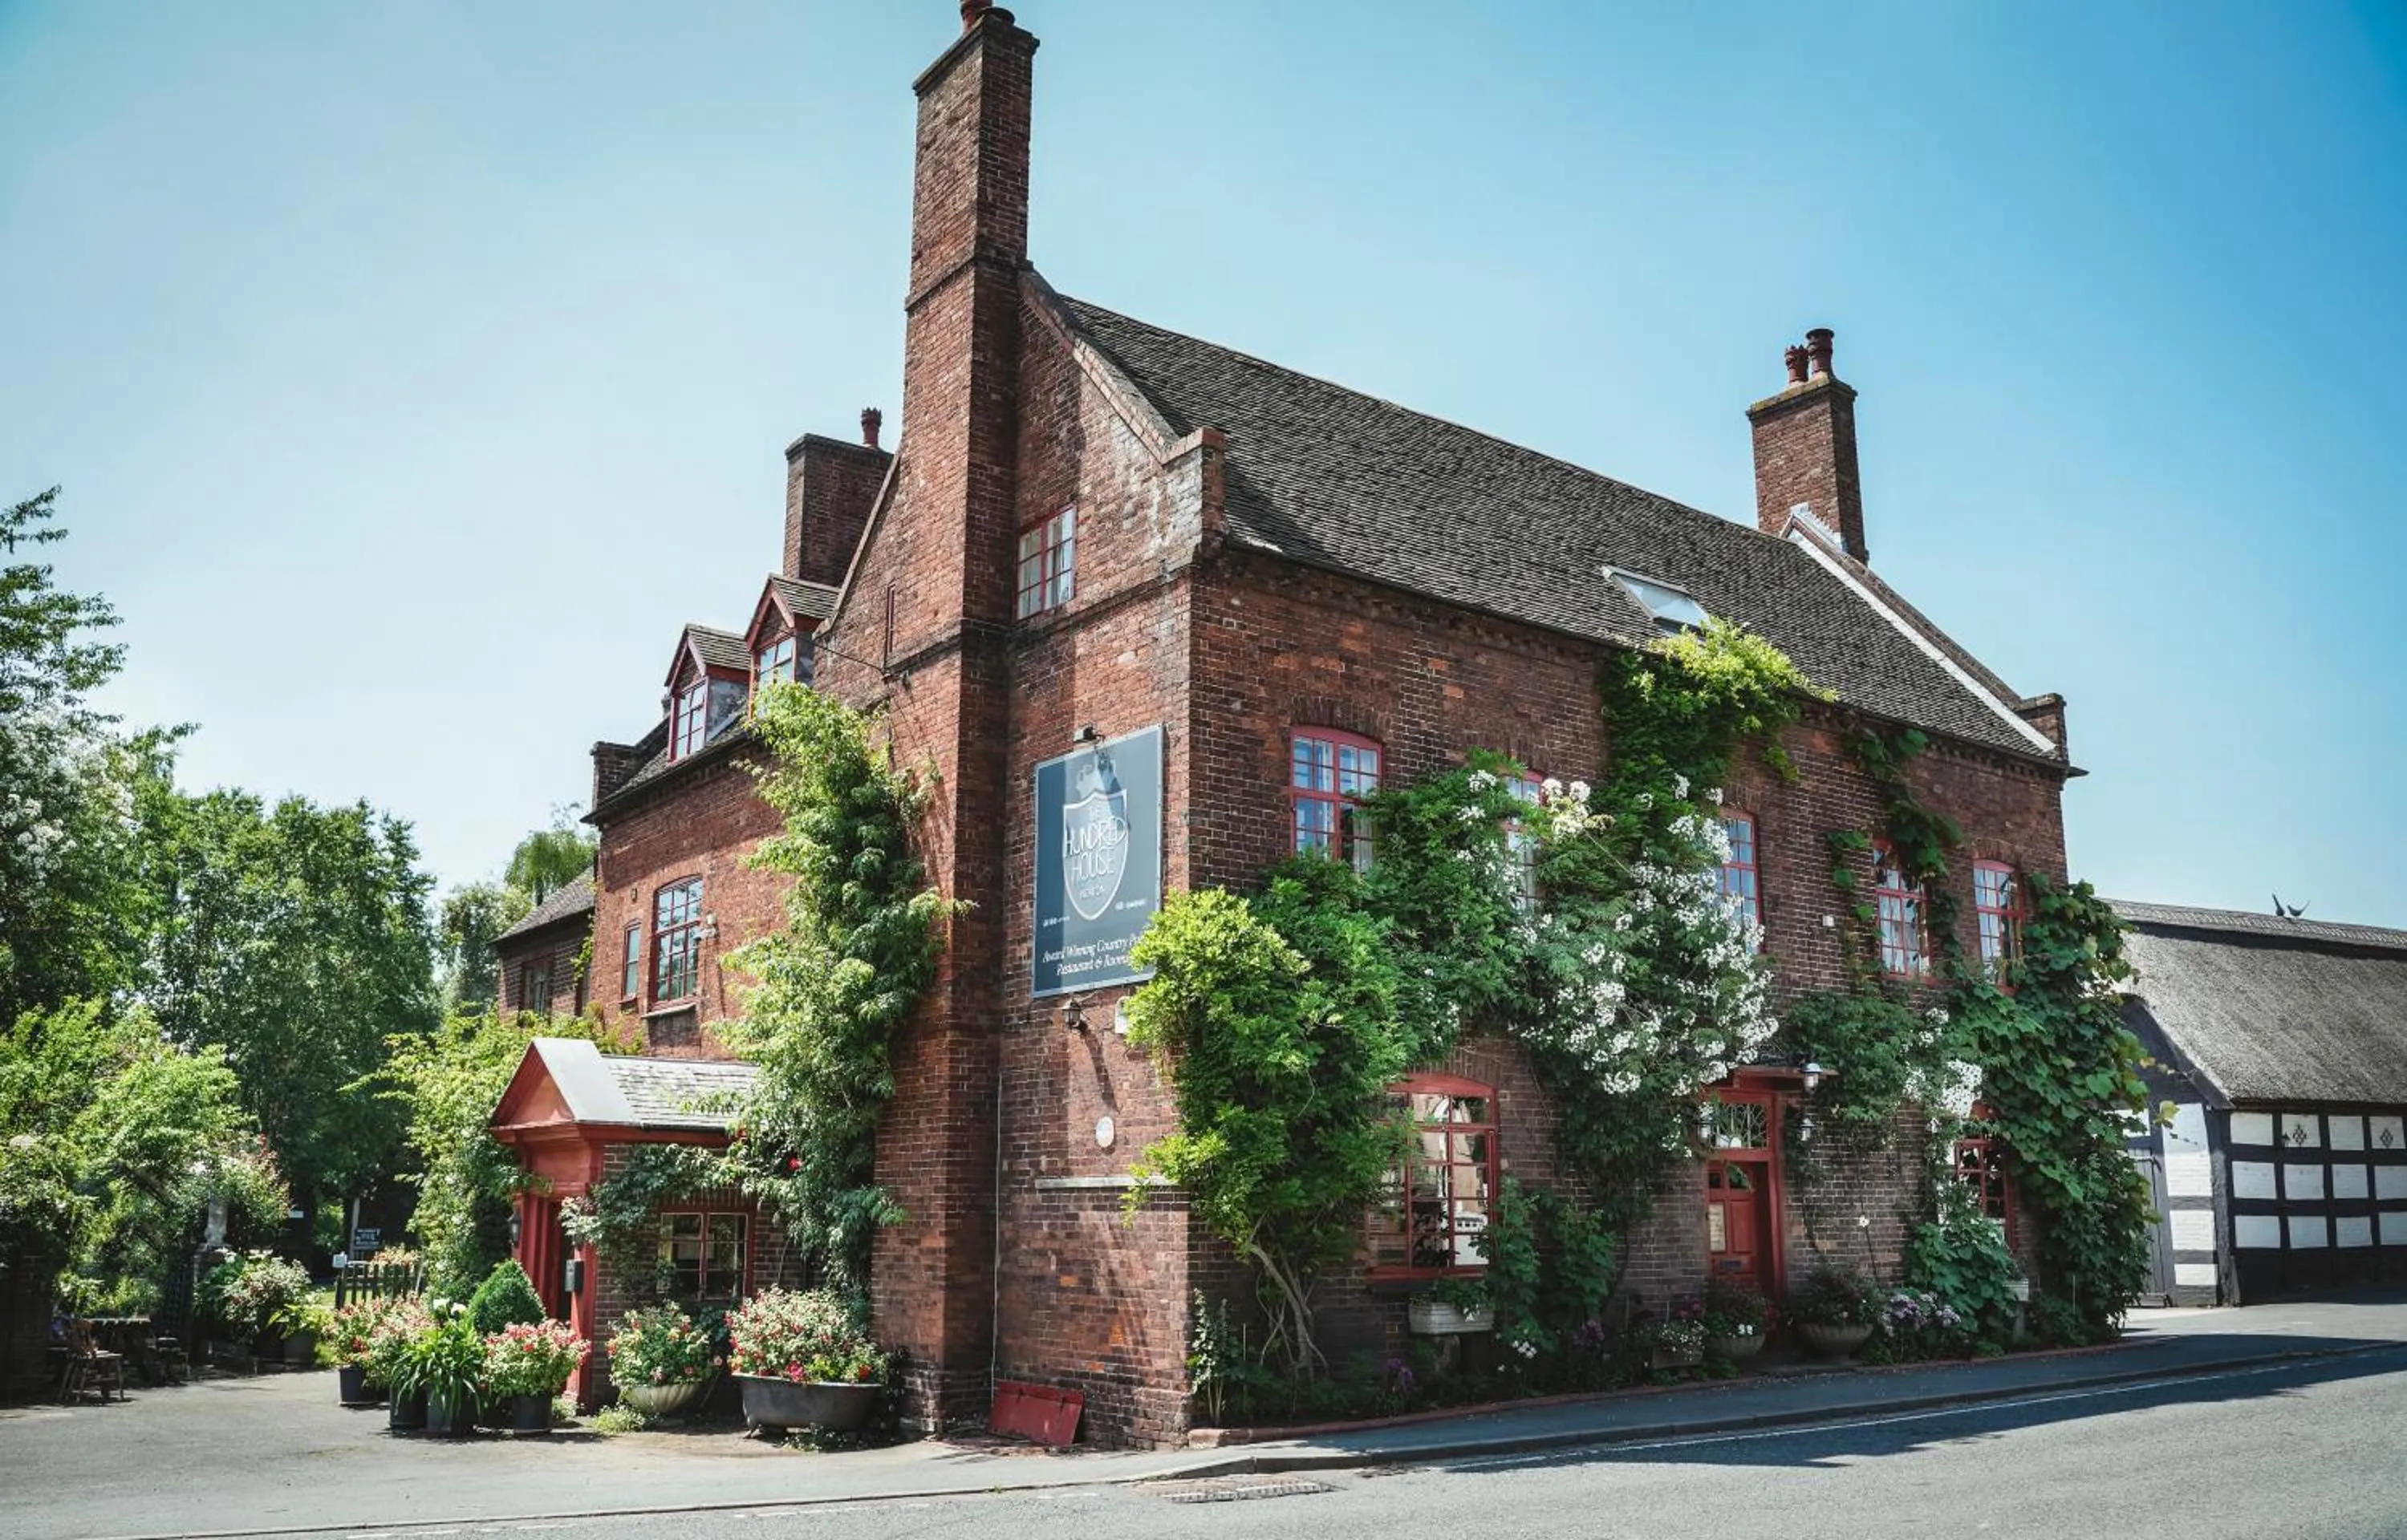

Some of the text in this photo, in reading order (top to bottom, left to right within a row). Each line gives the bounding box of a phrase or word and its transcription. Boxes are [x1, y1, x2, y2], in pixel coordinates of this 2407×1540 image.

[1064, 816, 1126, 857] HUNDRED
[1071, 847, 1114, 886] HOUSE
[1097, 938, 1127, 952] Country
